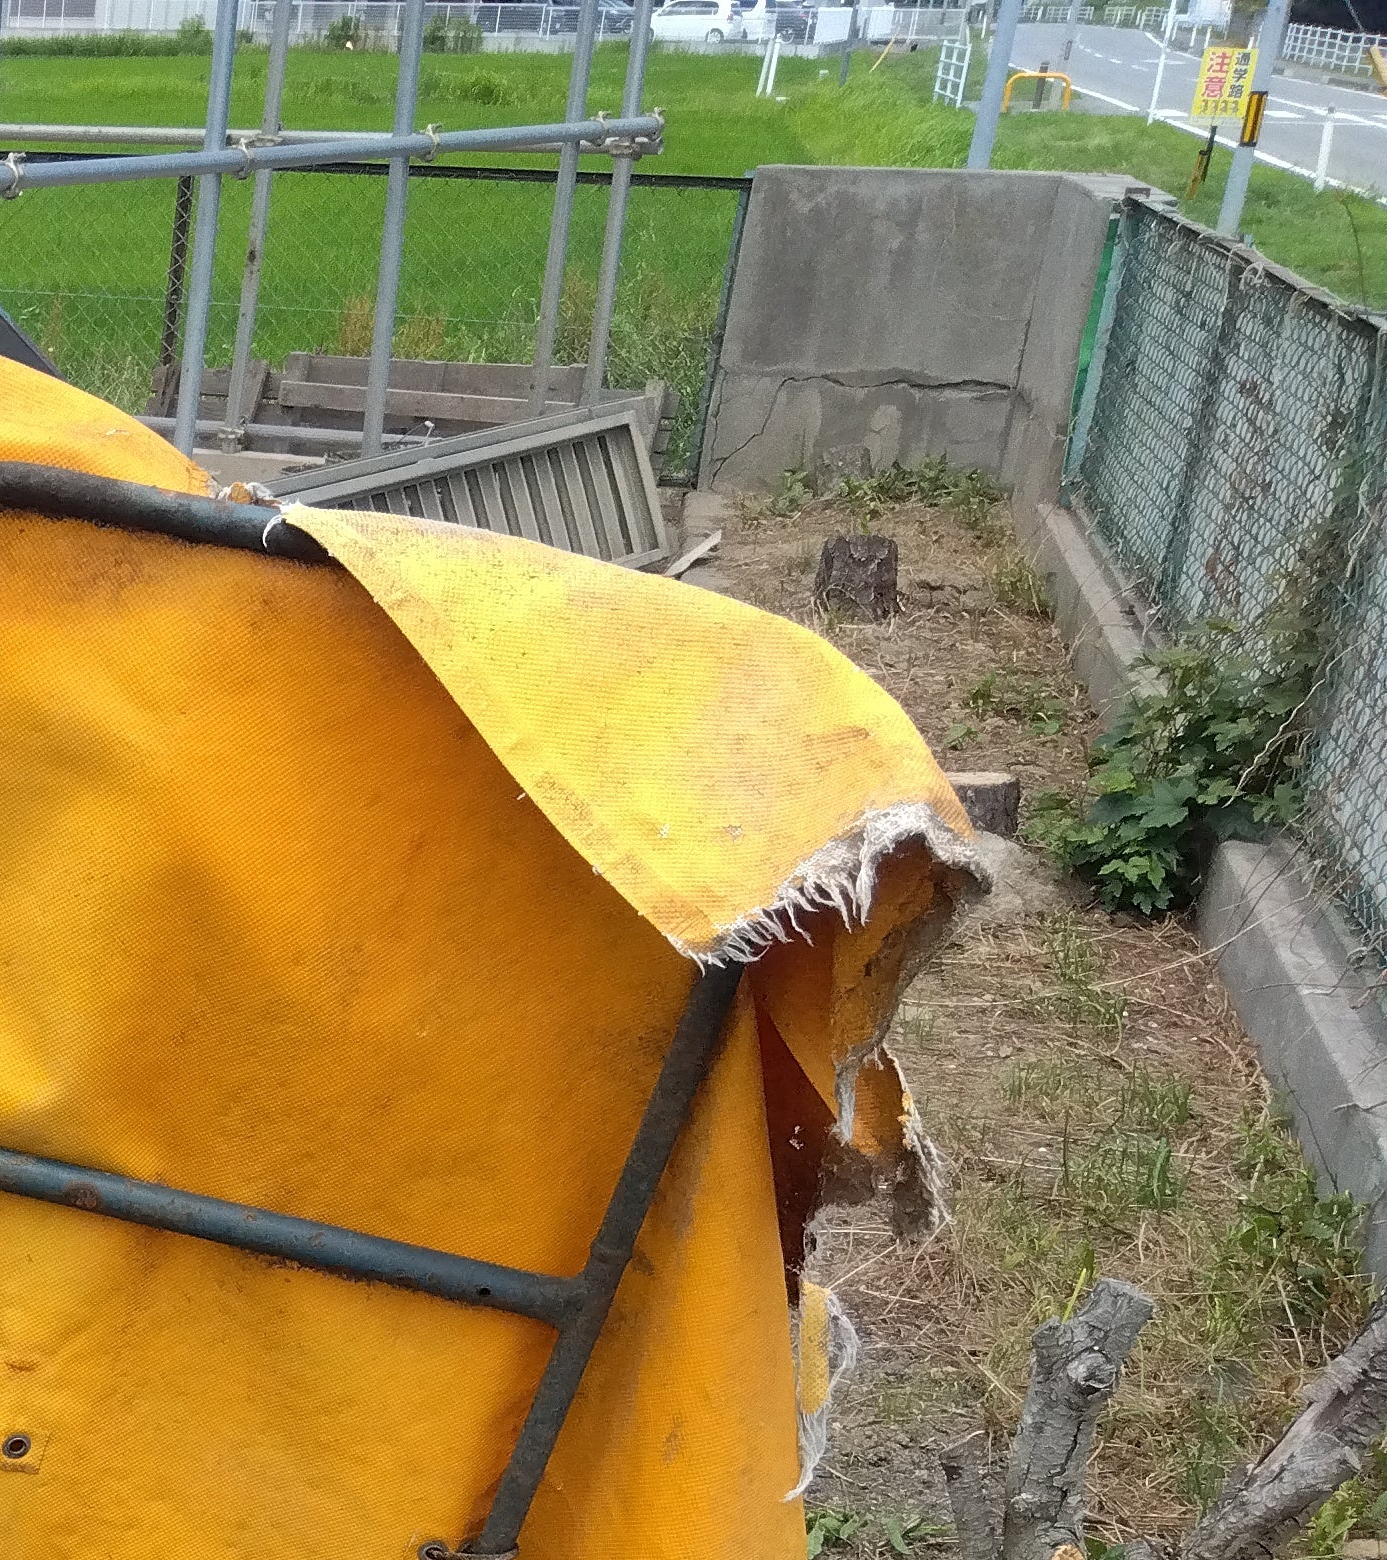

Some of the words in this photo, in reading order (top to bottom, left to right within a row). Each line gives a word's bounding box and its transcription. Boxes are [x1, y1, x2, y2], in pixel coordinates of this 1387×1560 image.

[1201, 51, 1231, 98] 注意
[1227, 51, 1251, 98] 通学路
